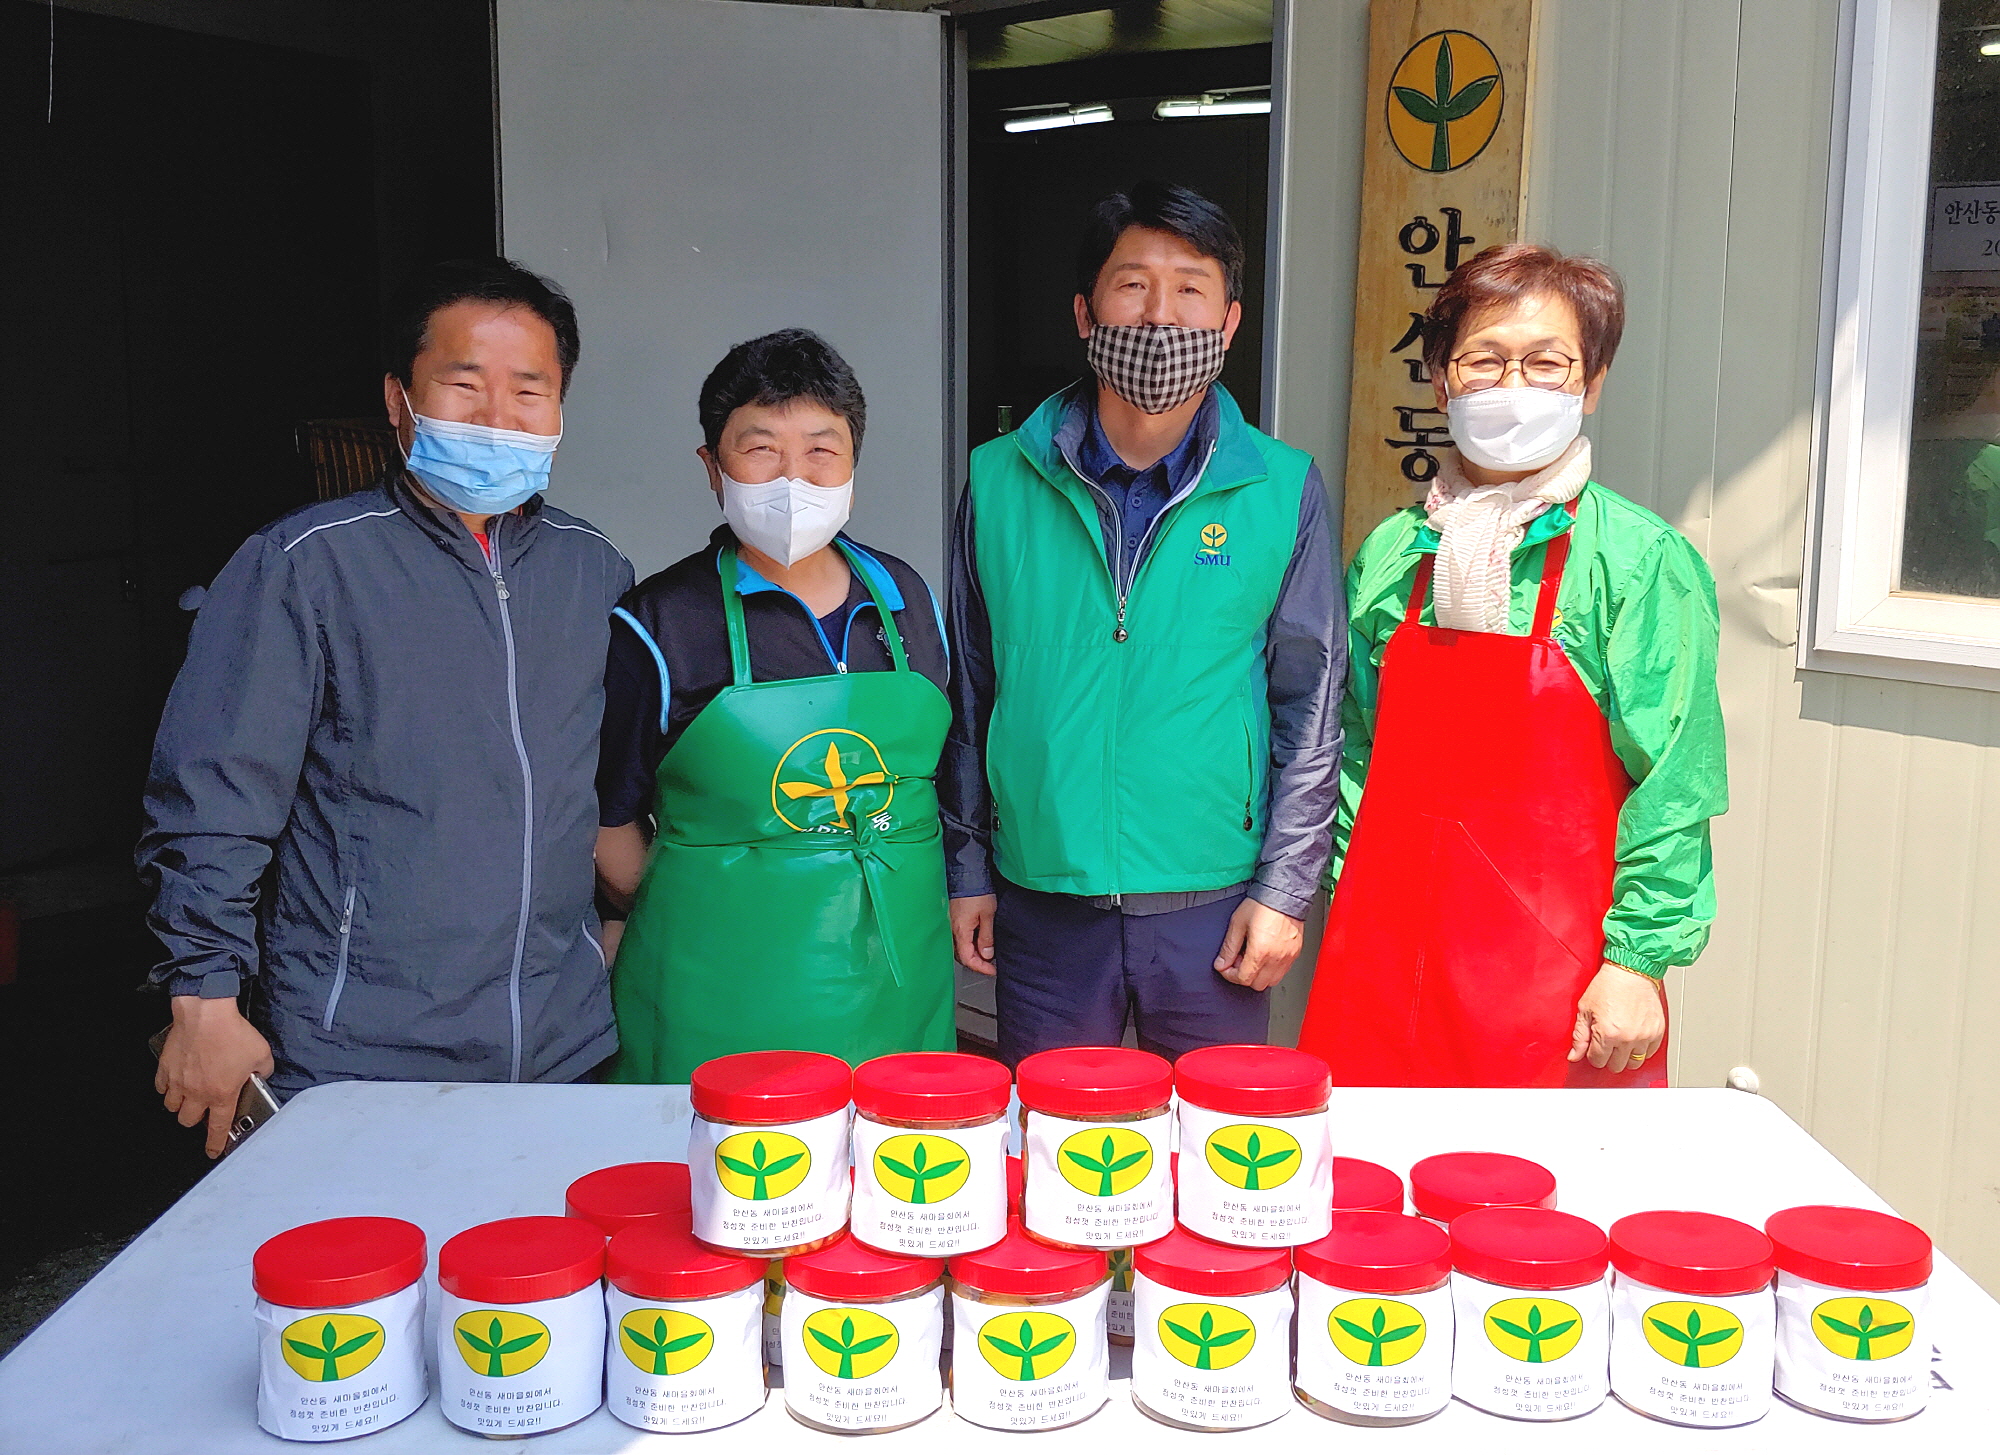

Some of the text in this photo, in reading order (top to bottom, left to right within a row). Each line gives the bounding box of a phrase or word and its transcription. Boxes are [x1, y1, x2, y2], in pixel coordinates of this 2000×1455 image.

[1194, 553, 1231, 566] SMU
[733, 1202, 814, 1218] 안산동 새마을회에서
[1077, 1200, 1153, 1213] 안산동 새마을회에서
[1223, 1200, 1301, 1214] 안산동 새마을회에서
[890, 1210, 970, 1222] 안산동 새마을회에서
[1065, 1215, 1089, 1226] 정성껏
[1094, 1218, 1119, 1227] 준비한
[1211, 1211, 1235, 1224] 정성껏
[1239, 1217, 1265, 1227] 준비한
[722, 1220, 745, 1231] 정성껏
[750, 1222, 776, 1231] 준비한
[879, 1221, 902, 1232] 정성껏
[907, 1225, 932, 1235] 준비한
[743, 1231, 805, 1245] 맛있게 드세요!!
[1085, 1229, 1144, 1240] 맛있게 드세요!!
[1231, 1229, 1291, 1241] 맛있게 드세요!!
[899, 1238, 960, 1249] 맛있게 드세요!!
[1174, 1378, 1198, 1390] 안산동
[1345, 1372, 1371, 1384] 안산동
[1505, 1374, 1530, 1386] 안산동
[1661, 1376, 1687, 1389] 안산동
[1832, 1372, 1860, 1384] 안산동
[300, 1383, 389, 1406] 안산동 새마을회에서
[469, 1387, 552, 1400] 안산동 새마을회에서
[634, 1386, 657, 1398] 안산동
[818, 1382, 842, 1395] 안산동
[999, 1388, 1025, 1398] 안산동
[1362, 1388, 1388, 1399] 준비한
[1524, 1390, 1549, 1399] 준비한
[1851, 1388, 1878, 1398] 준비한
[834, 1400, 859, 1411] 준비한
[1190, 1396, 1216, 1406] 준비한
[1679, 1394, 1706, 1405] 준비한
[485, 1404, 511, 1415] 준비한
[650, 1402, 676, 1413] 준비한
[1018, 1402, 1043, 1411] 준비한
[1353, 1401, 1379, 1412] 맛있게
[1515, 1402, 1542, 1413] 맛있게
[1670, 1405, 1697, 1417] 맛있게
[1842, 1401, 1869, 1411] 맛있게
[289, 1409, 315, 1420] 정성껏
[320, 1407, 348, 1419] 준비한
[826, 1412, 850, 1424] 맛있게
[1181, 1408, 1207, 1420] 맛있게
[311, 1414, 379, 1434] 맛있게 드세요!!
[477, 1417, 541, 1428] 맛있게 드세요!!
[643, 1414, 668, 1426] 맛있게
[1010, 1416, 1036, 1426] 맛있게
